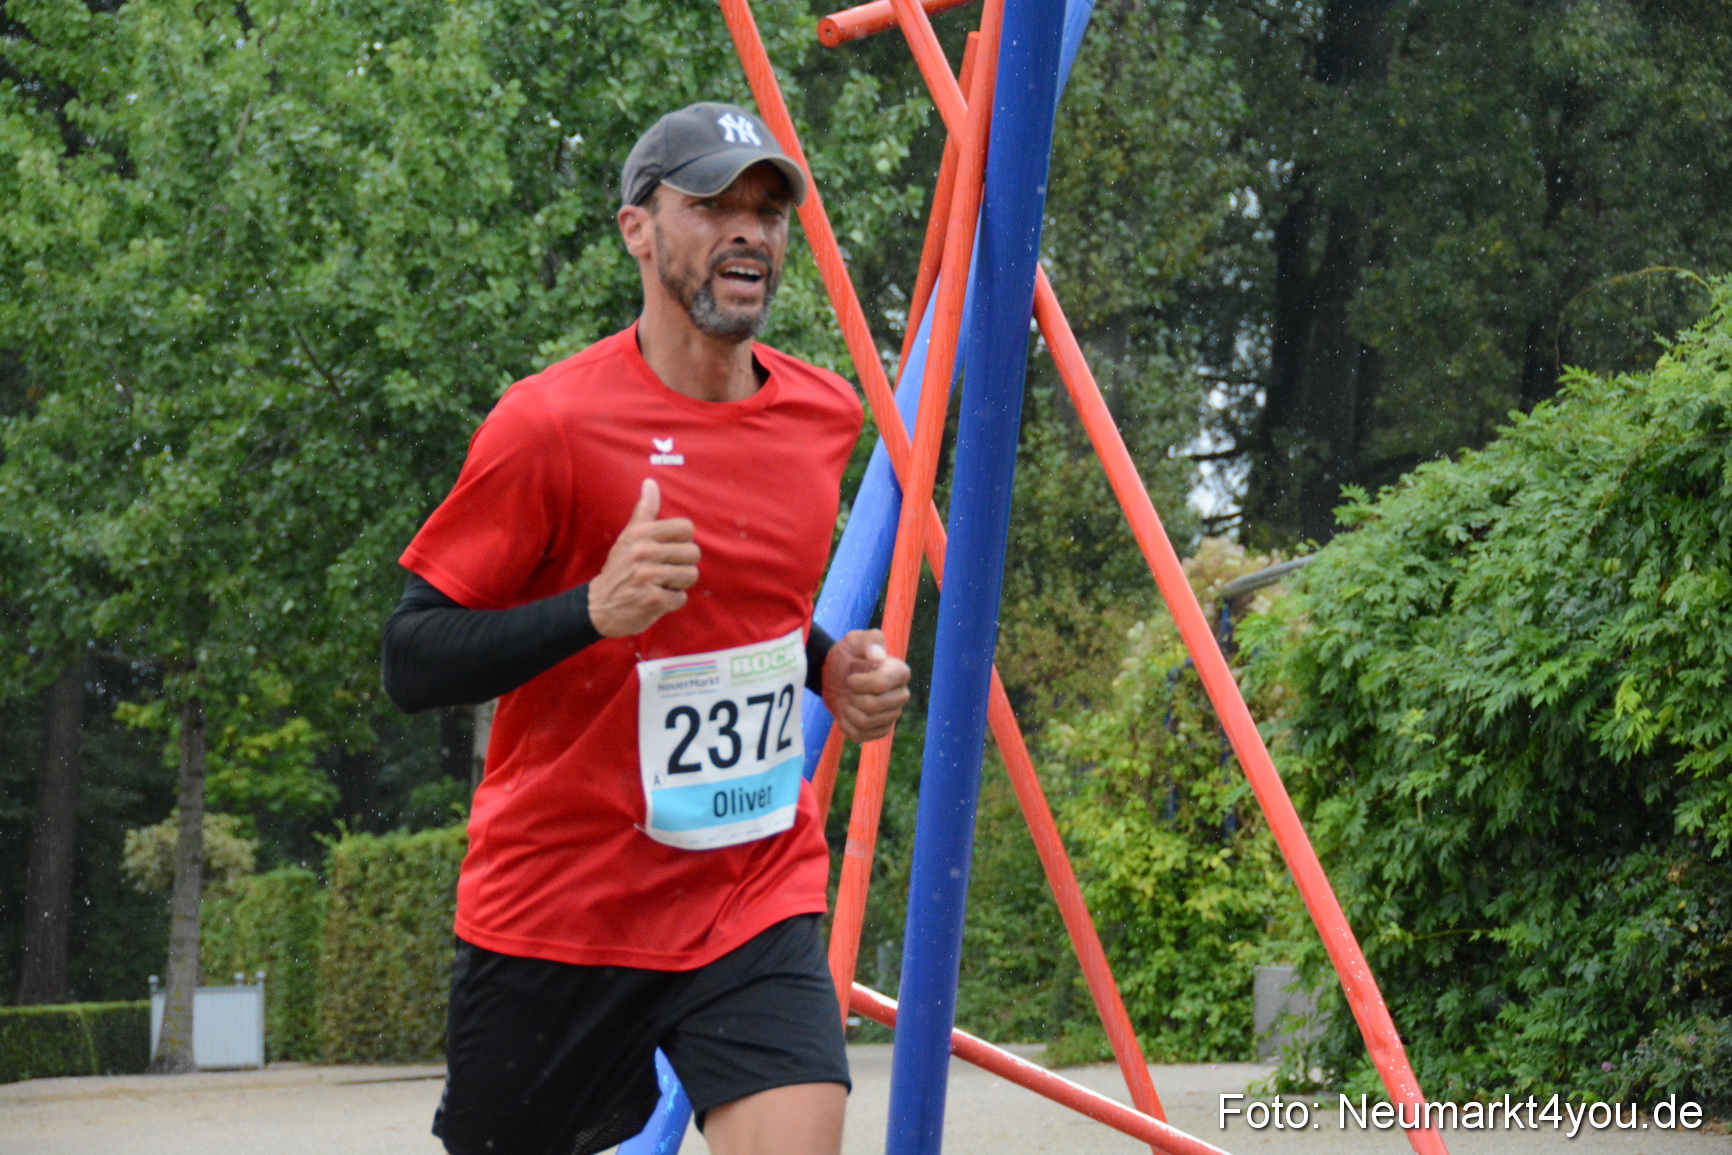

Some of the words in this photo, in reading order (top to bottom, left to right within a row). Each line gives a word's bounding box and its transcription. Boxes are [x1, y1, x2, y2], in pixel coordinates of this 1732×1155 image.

[657, 676, 721, 693] NeuerMarkt
[664, 683, 796, 776] 2372
[713, 785, 773, 819] Oliver
